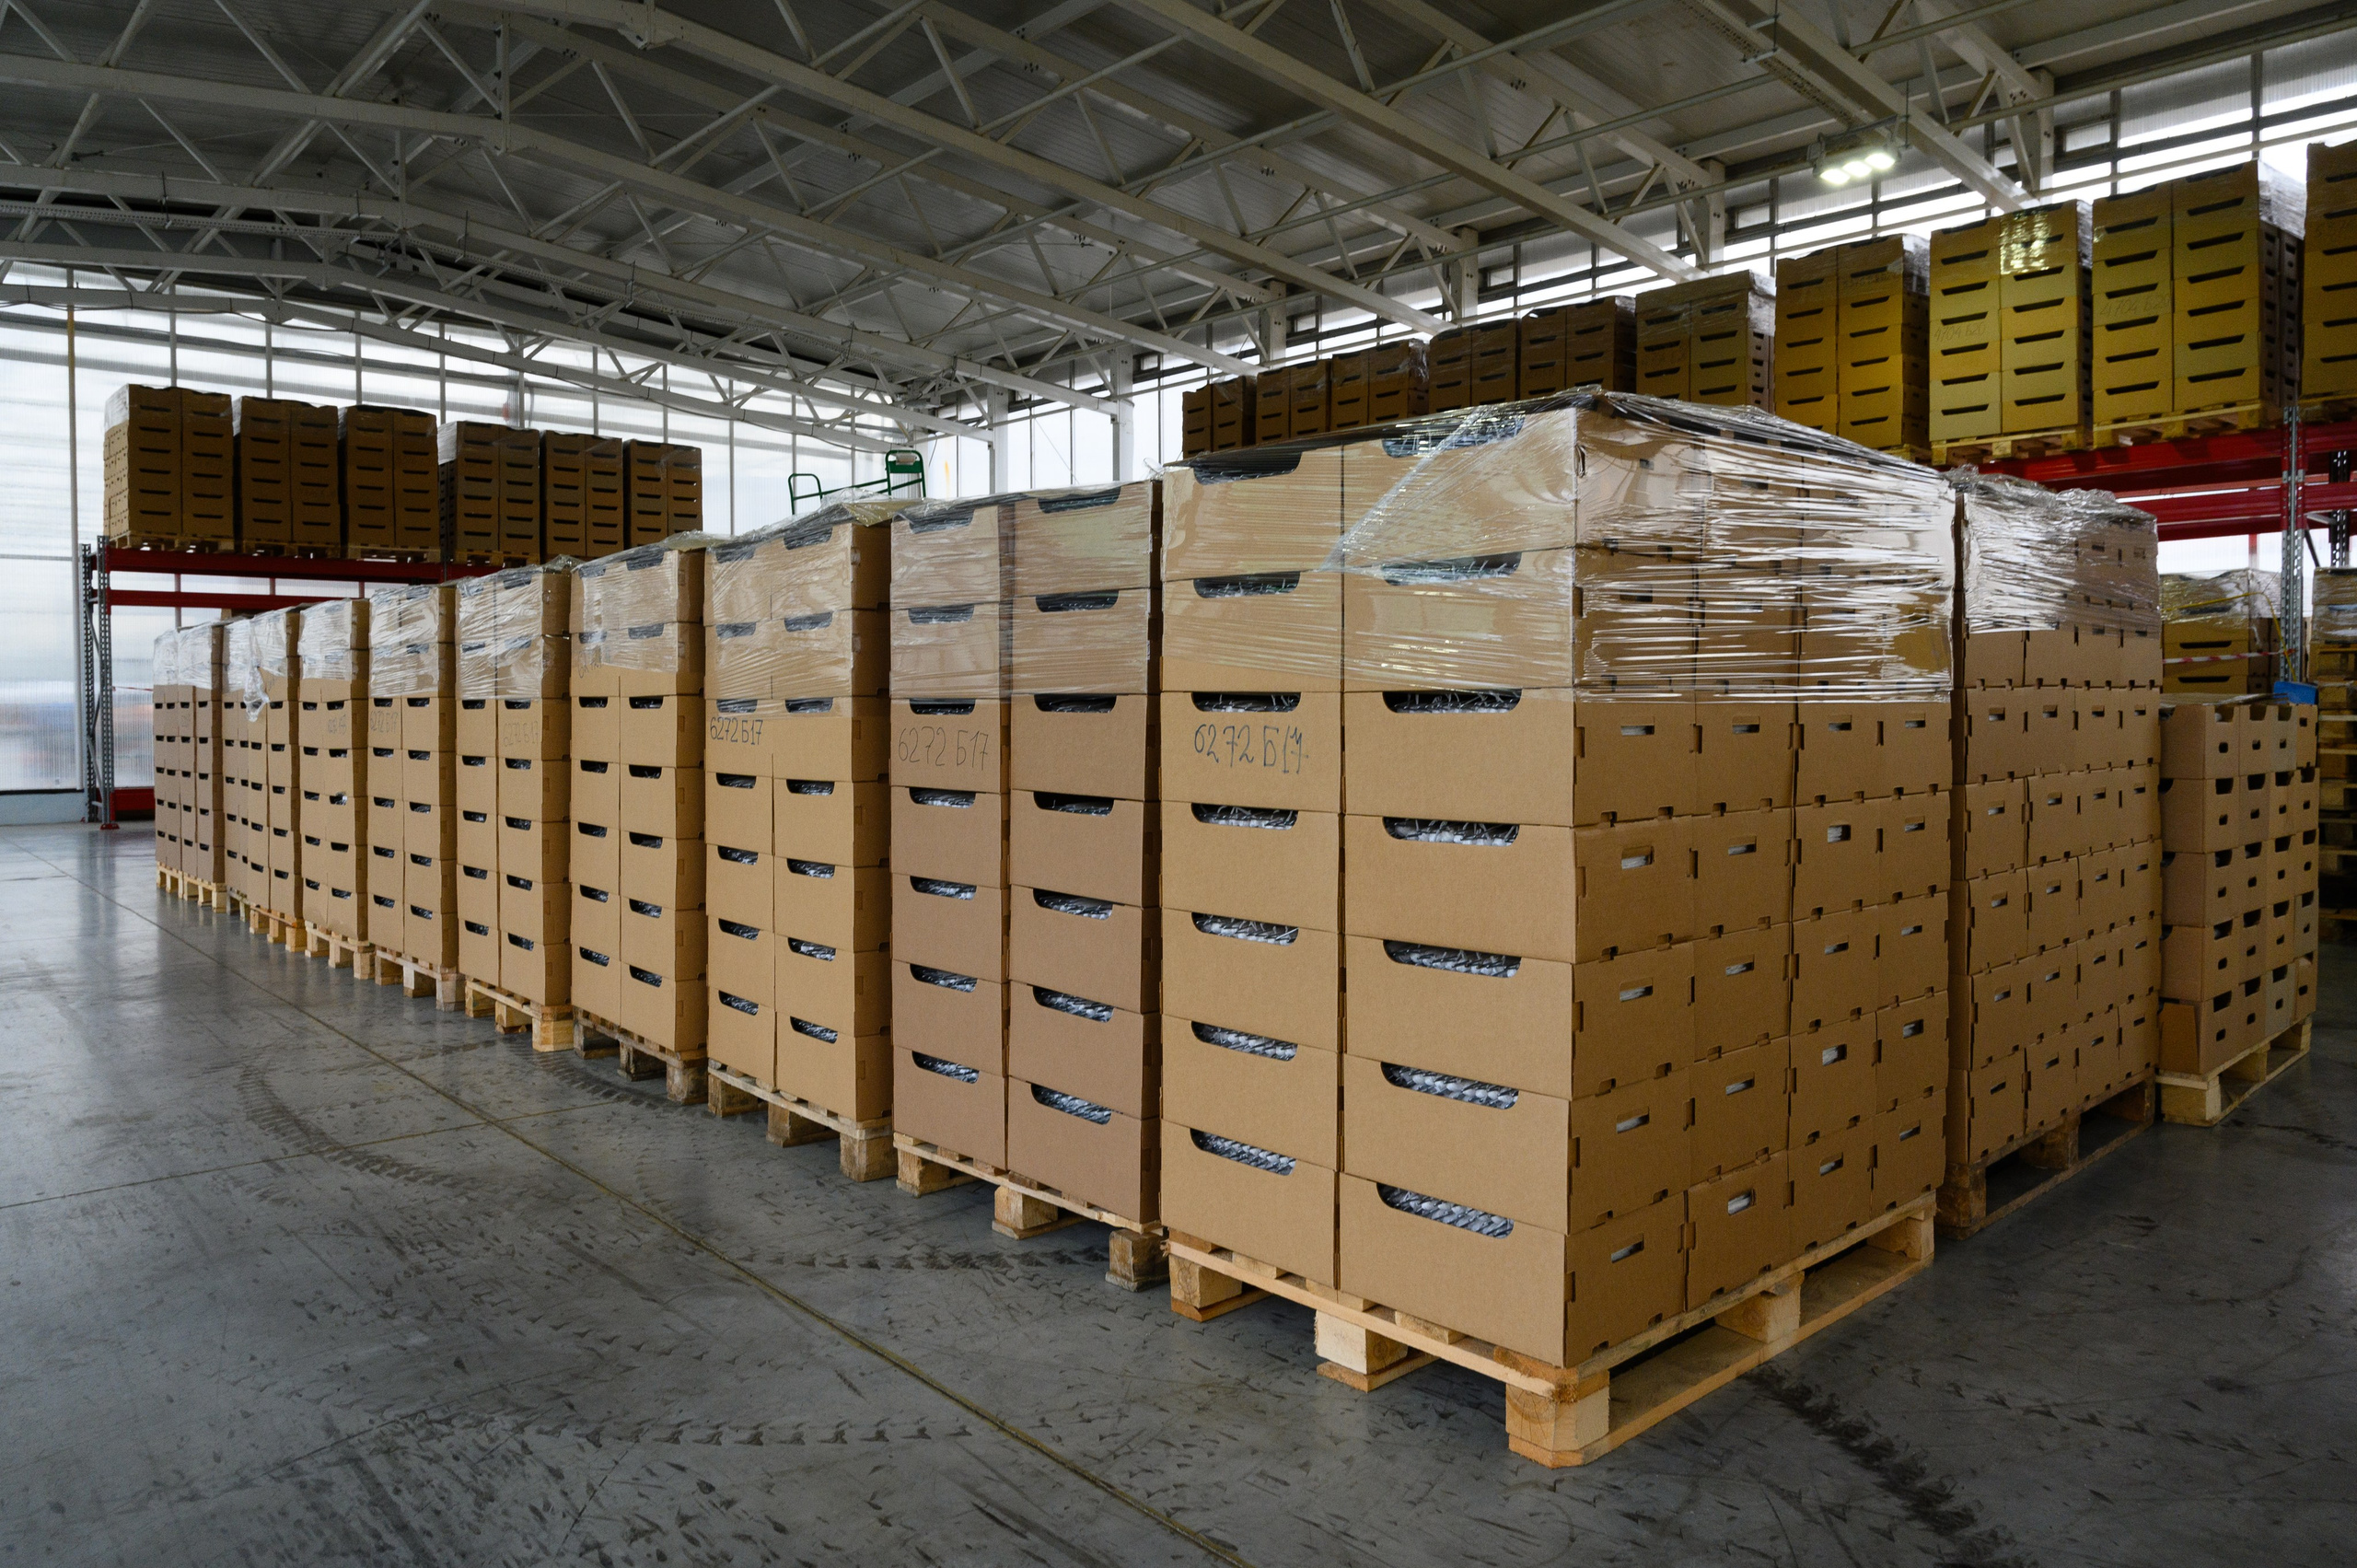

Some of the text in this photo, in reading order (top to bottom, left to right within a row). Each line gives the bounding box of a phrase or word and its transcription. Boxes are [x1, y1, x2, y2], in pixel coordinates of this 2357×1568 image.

[710, 716, 738, 743] 6272
[899, 726, 946, 767] 6272
[1194, 724, 1255, 768] 6272
